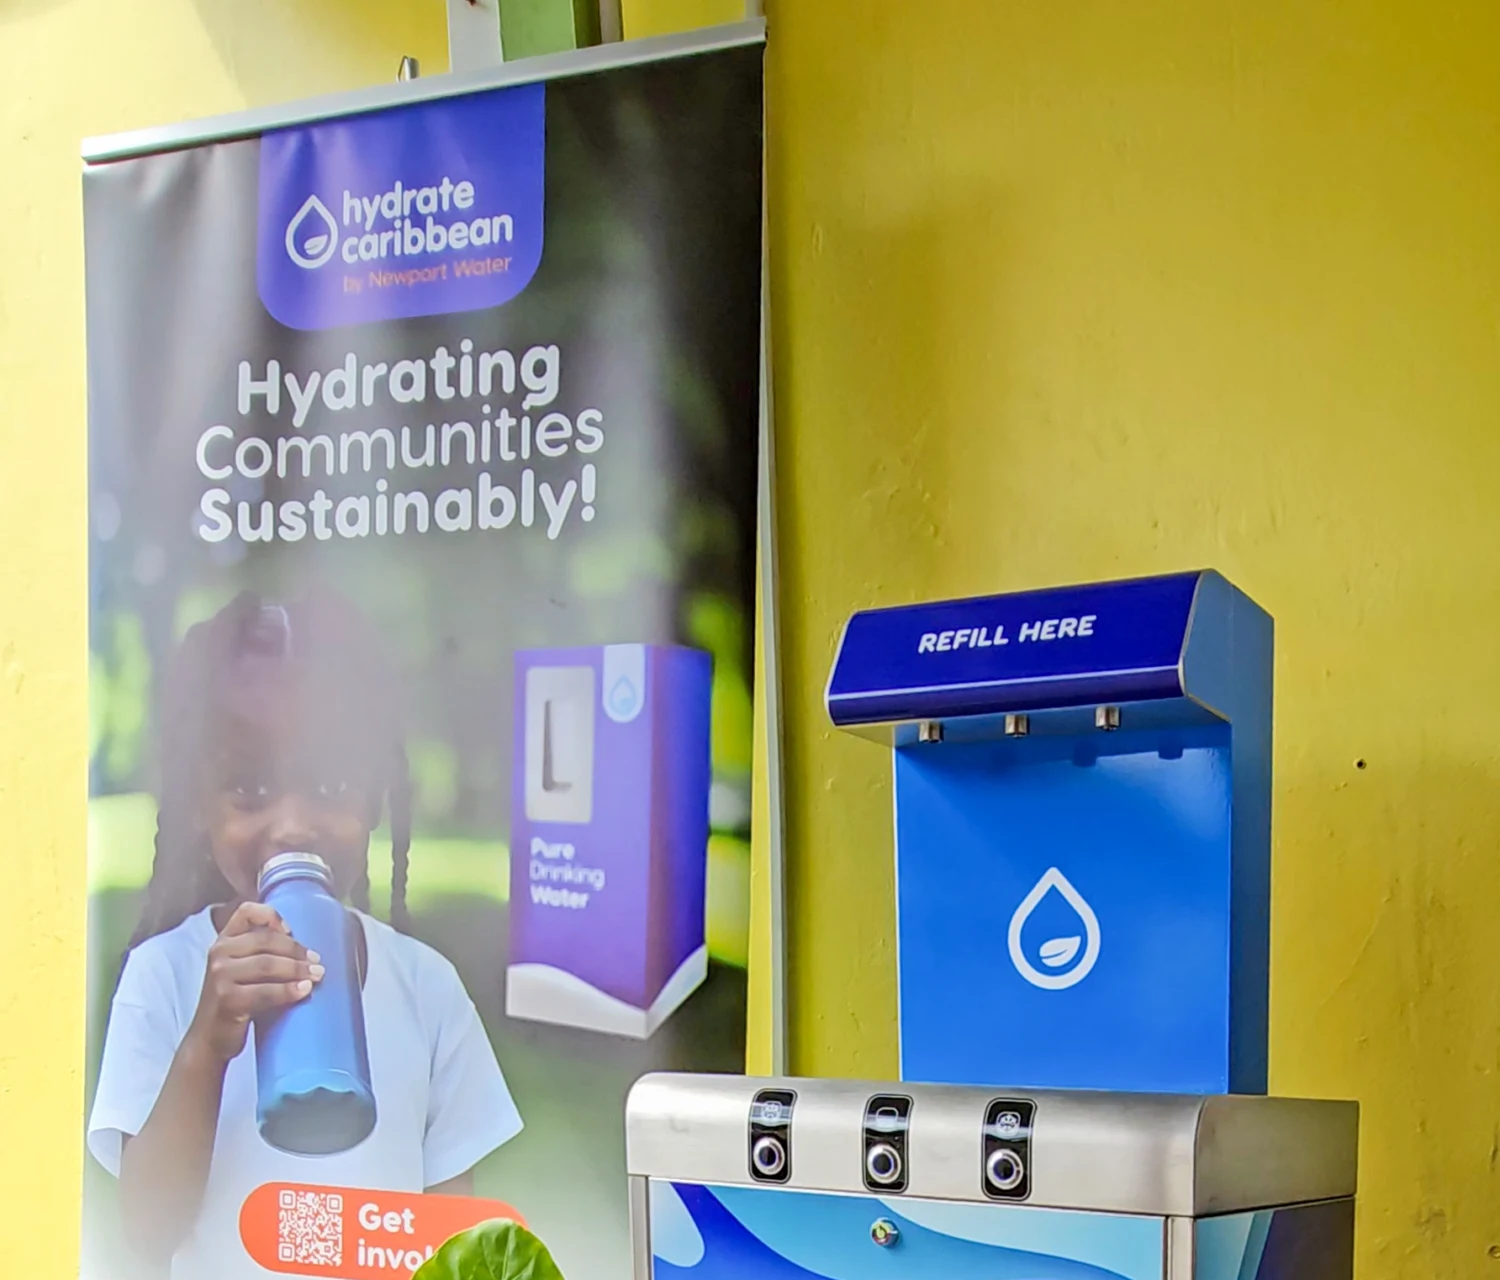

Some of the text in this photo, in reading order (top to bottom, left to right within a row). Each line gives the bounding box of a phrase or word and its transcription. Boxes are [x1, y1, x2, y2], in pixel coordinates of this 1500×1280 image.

[343, 176, 475, 231] hydrate
[341, 214, 514, 264] caribbean
[343, 257, 512, 293] by Newport Water
[237, 339, 560, 426] Hydrating
[196, 404, 604, 480] Communities
[199, 464, 597, 541] Sustainably!
[918, 615, 1097, 654] REFILL HERE
[530, 836, 575, 860] Pure
[529, 859, 606, 892] Drinking
[530, 884, 589, 909] Water
[358, 1203, 415, 1235] Get
